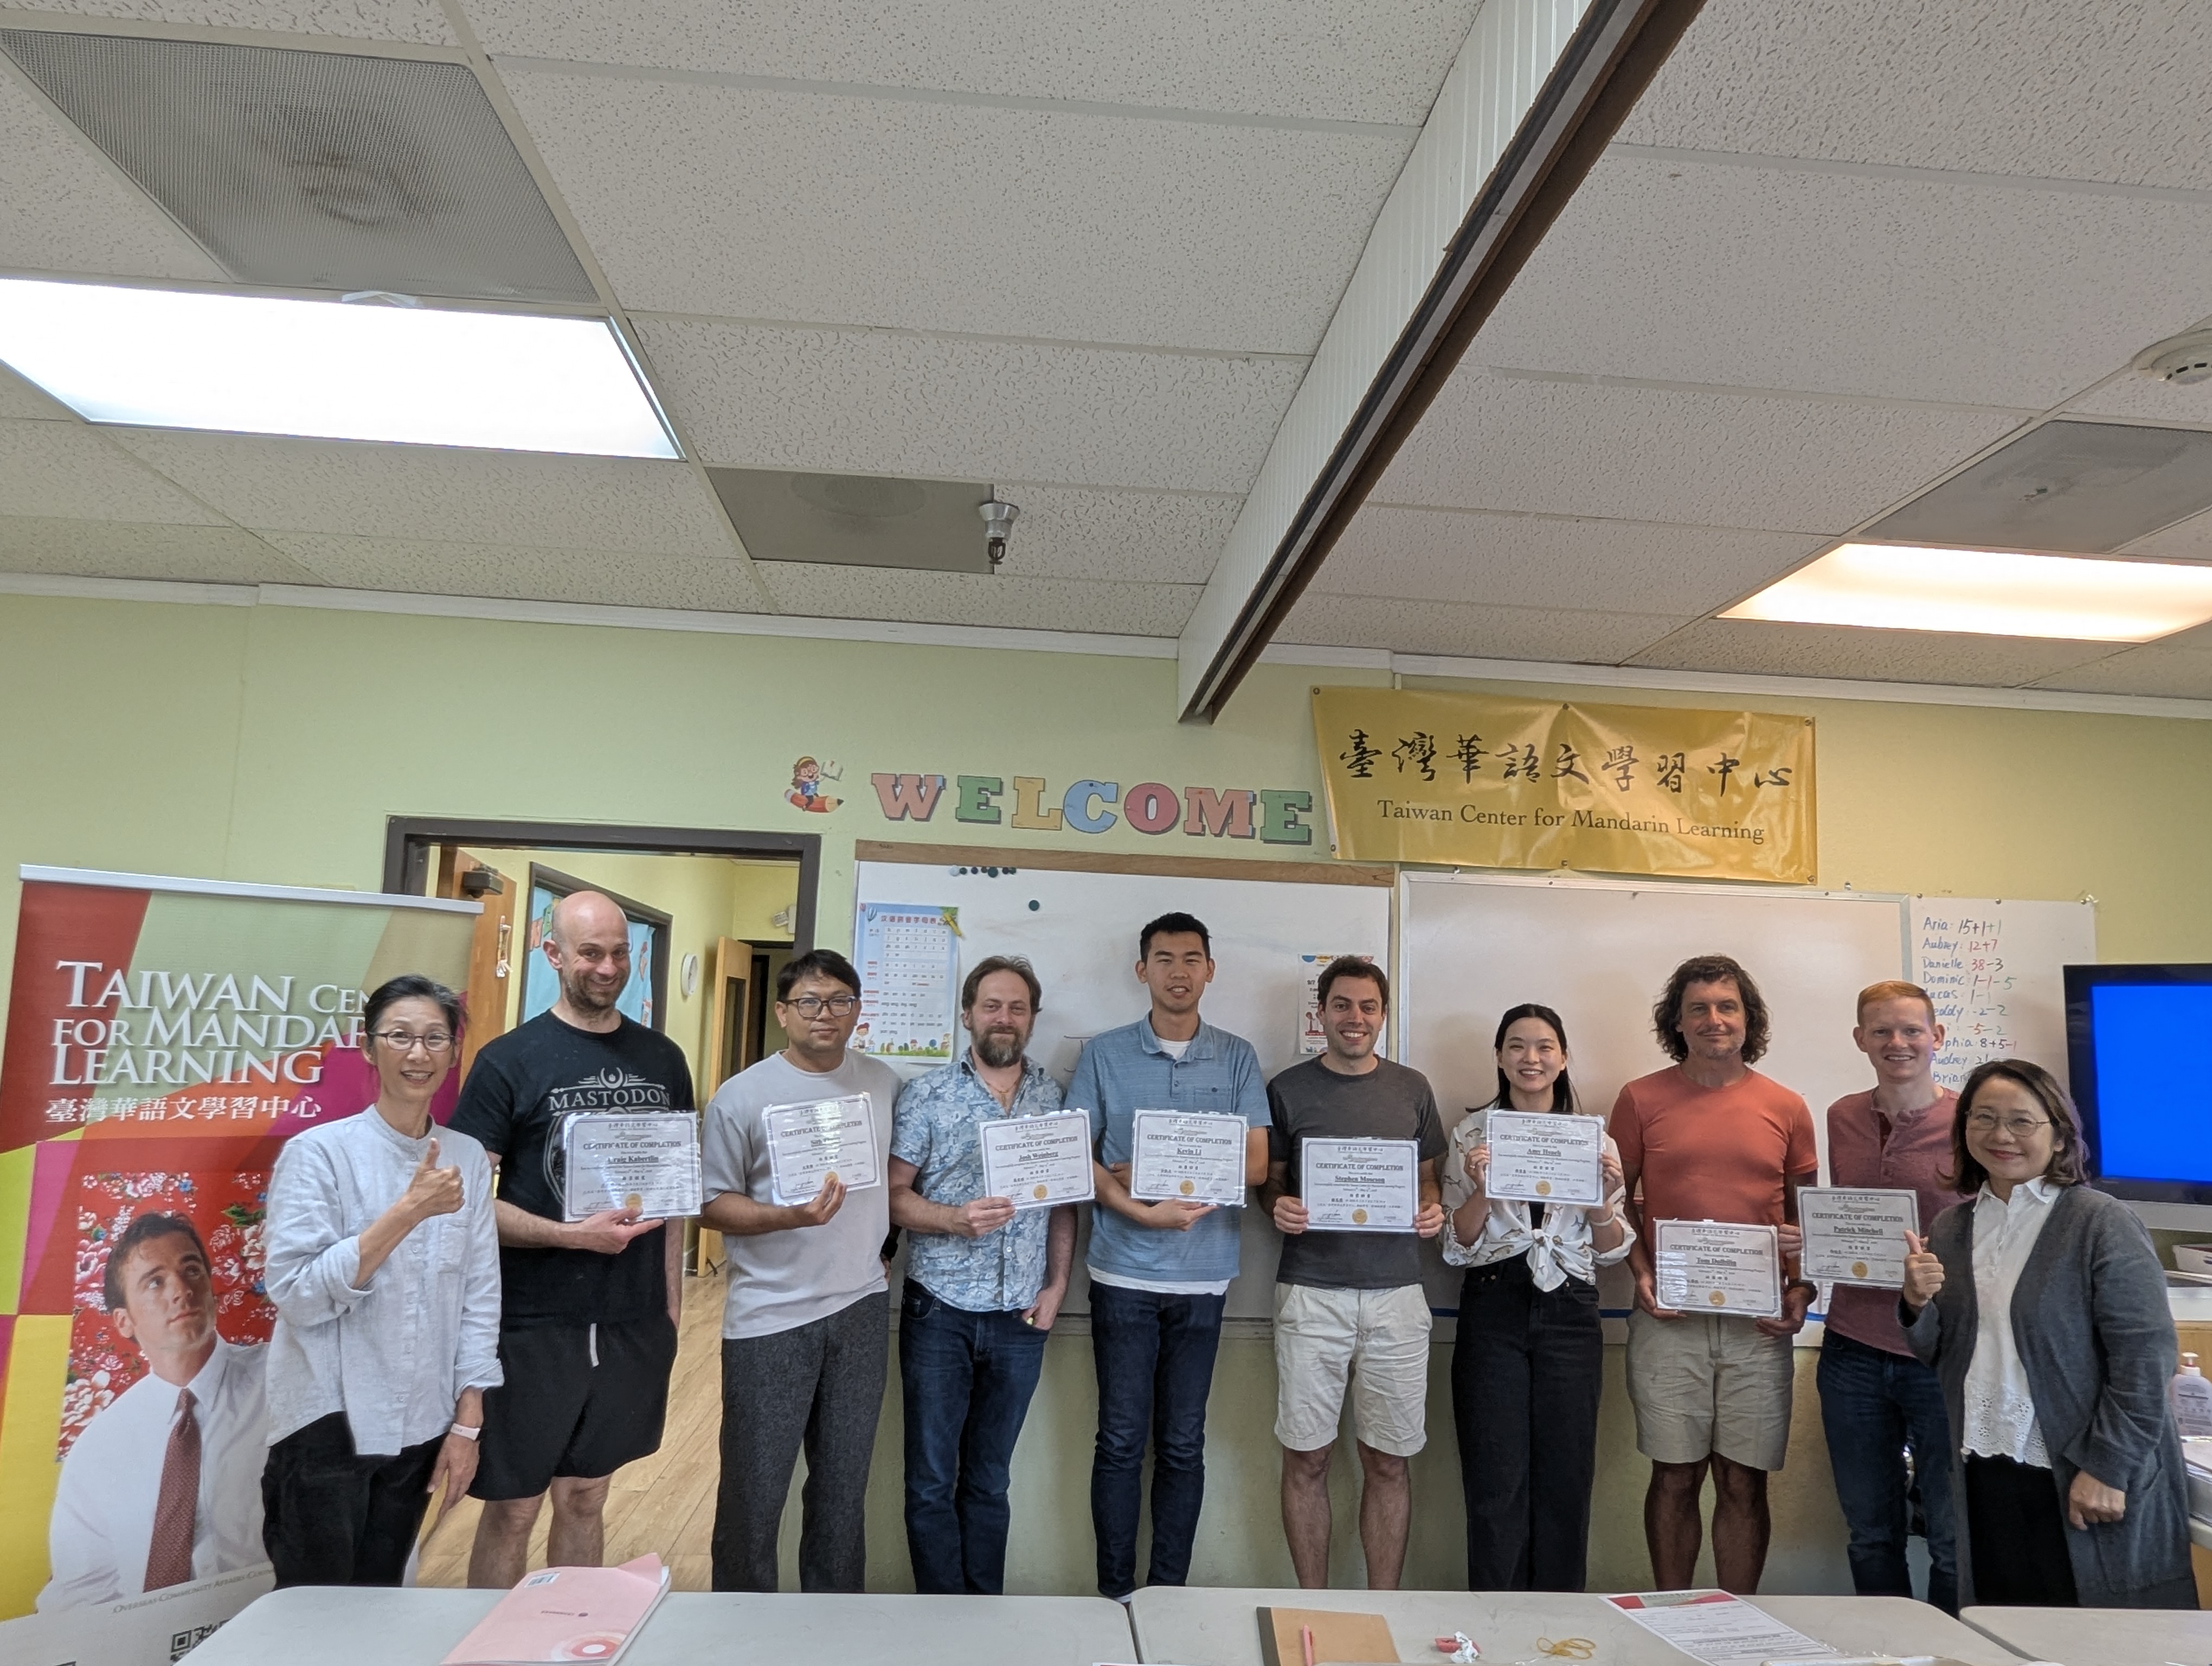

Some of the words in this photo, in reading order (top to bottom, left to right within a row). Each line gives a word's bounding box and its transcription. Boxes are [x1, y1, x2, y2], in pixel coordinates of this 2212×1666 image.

[1339, 728, 1792, 797] 臺灣華語文學習中心
[871, 773, 1312, 845] WELCOME
[1377, 799, 1452, 822] Taiwan
[1460, 804, 1527, 826] Center
[1534, 808, 1565, 826] for
[1571, 810, 1669, 833] Mandarin
[1676, 817, 1765, 845] Learning
[1968, 939, 1998, 952] 12+7
[1971, 958, 2004, 972] 38-3
[56, 960, 295, 1012] TAIWAN
[309, 984, 370, 1014] CEN
[53, 1018, 135, 1047] FOR
[142, 1006, 365, 1049] MANDAR
[1945, 1037, 1973, 1052] phia
[49, 1043, 324, 1085] LEARNING
[549, 1089, 671, 1111] MASTODON
[46, 1096, 322, 1123] 臺灣華語文學習中心
[640, 1140, 681, 1149] COMPLETION
[995, 1140, 1034, 1151] CERTIFICATE
[1043, 1136, 1078, 1146] COMPLETION
[1147, 1134, 1186, 1142] CERTIFICATE
[1500, 1134, 1541, 1143] CERTIFICATE
[1316, 1162, 1356, 1170] CERTIFICATE
[1812, 1212, 1853, 1220] CERTIFICATE
[1670, 1244, 1712, 1253] CERTIFICATE
